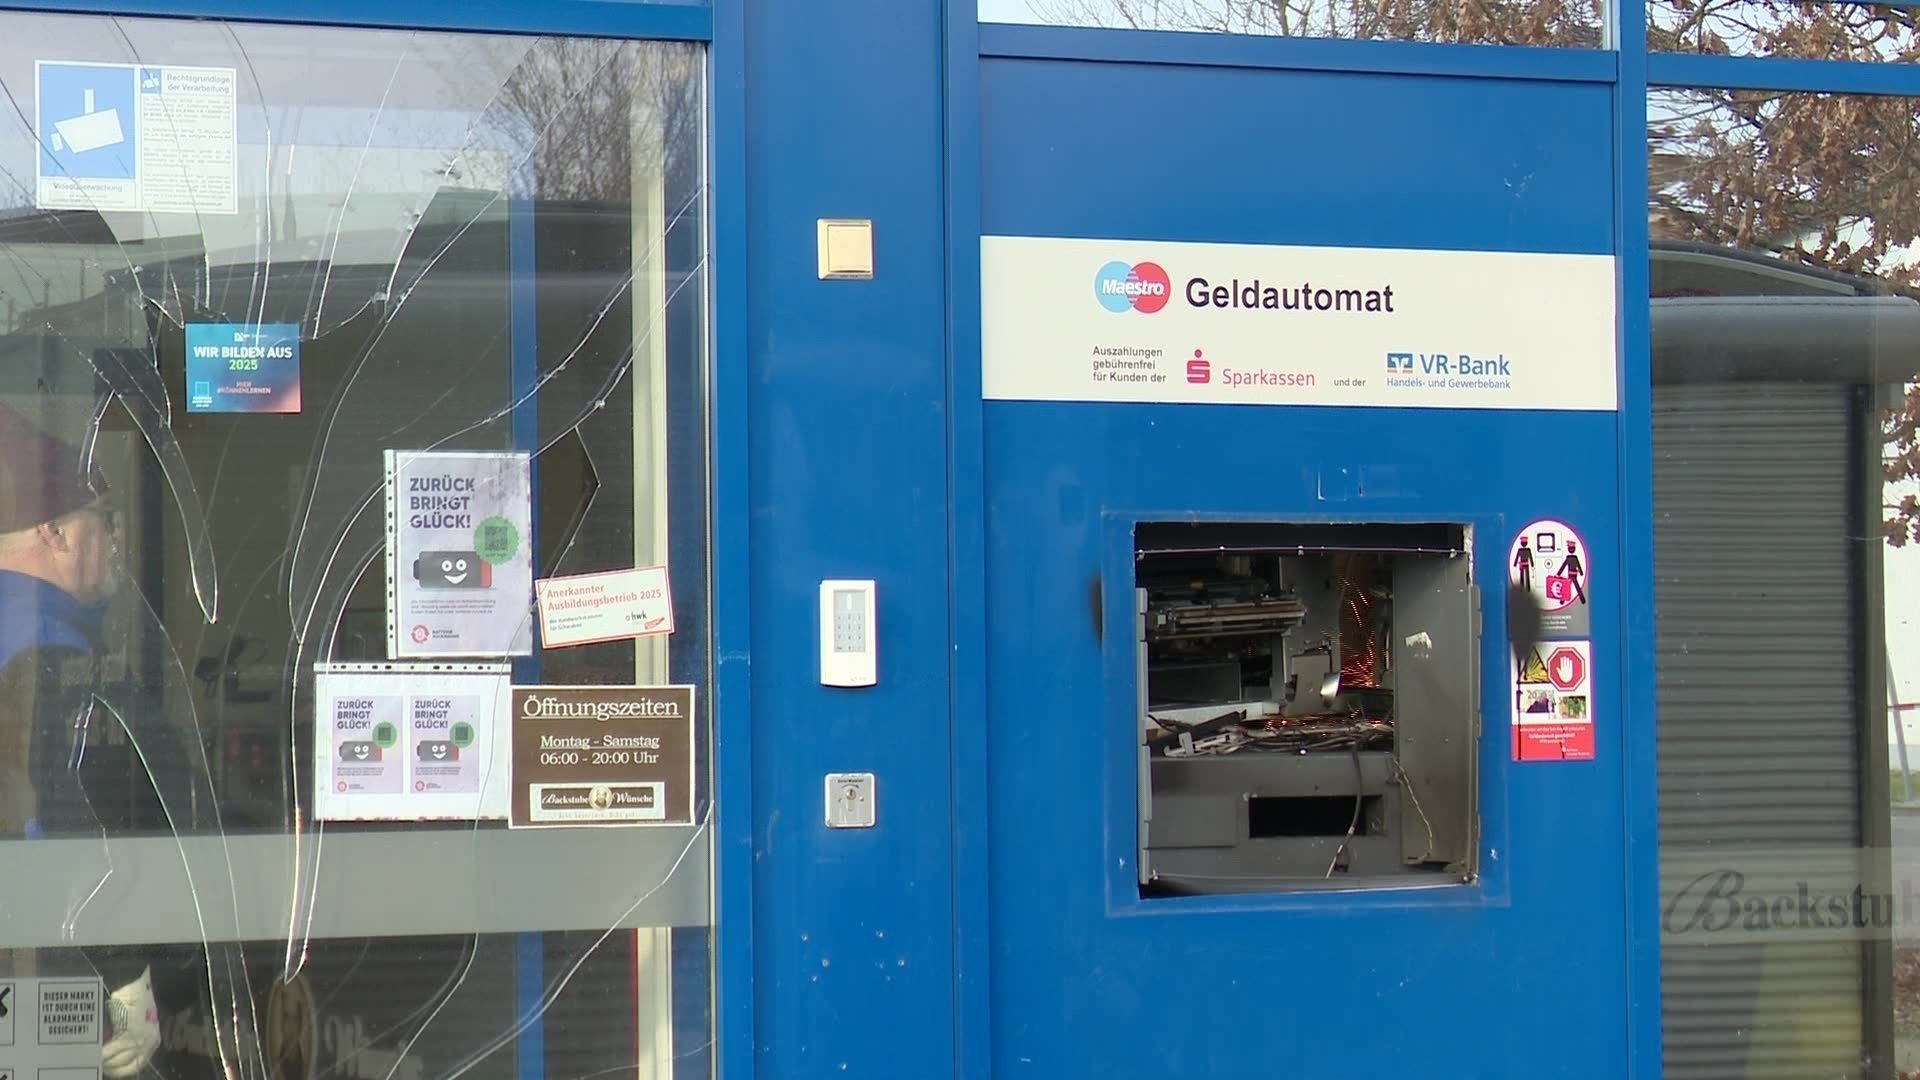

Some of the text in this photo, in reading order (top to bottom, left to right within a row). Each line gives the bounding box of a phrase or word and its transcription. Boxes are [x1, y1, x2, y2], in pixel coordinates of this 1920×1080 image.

[1102, 277, 1394, 312] Maestro Geldautomat
[193, 347, 293, 358] WIR BILDEN AUS
[1092, 346, 1163, 359] Auszahlungen
[229, 359, 258, 371] 2025
[1092, 359, 1156, 371] gebührenfrei
[1420, 354, 1511, 375] VR-Bank
[1092, 371, 1166, 383] für Kunden der
[1222, 368, 1315, 389] Sparkassen
[1333, 378, 1366, 387] und der
[1387, 377, 1511, 389] Handels- und Gewerbebank
[410, 475, 475, 492] ZURÜCK
[410, 496, 470, 510] BRINGT
[410, 511, 471, 528] GLÜCK!
[547, 585, 605, 599] Anerkannter
[548, 589, 662, 611] Ausbildungsbetrieb 2025
[631, 609, 648, 621] hwk
[337, 699, 374, 709] ZURÜCK
[415, 699, 451, 709] ZURÜCK
[523, 695, 679, 721] Öffnungszeiten
[337, 711, 371, 719] BRINGT
[415, 711, 448, 719] BRINGT
[337, 720, 371, 729] GLÜCK!
[415, 720, 448, 729] GLÜCK!
[540, 736, 590, 749] Montag
[603, 735, 660, 749] Samstag
[540, 752, 579, 765] 06:00
[592, 752, 630, 765] 20:00
[634, 751, 659, 764] Uhr
[542, 792, 653, 805] Backstube Wünsche
[44, 991, 94, 1001] DIESER MARKT
[42, 1002, 95, 1012] IST DURCH EINE
[43, 1014, 94, 1024] ALARMANLAGE
[48, 1025, 89, 1035] GESICHERT!
